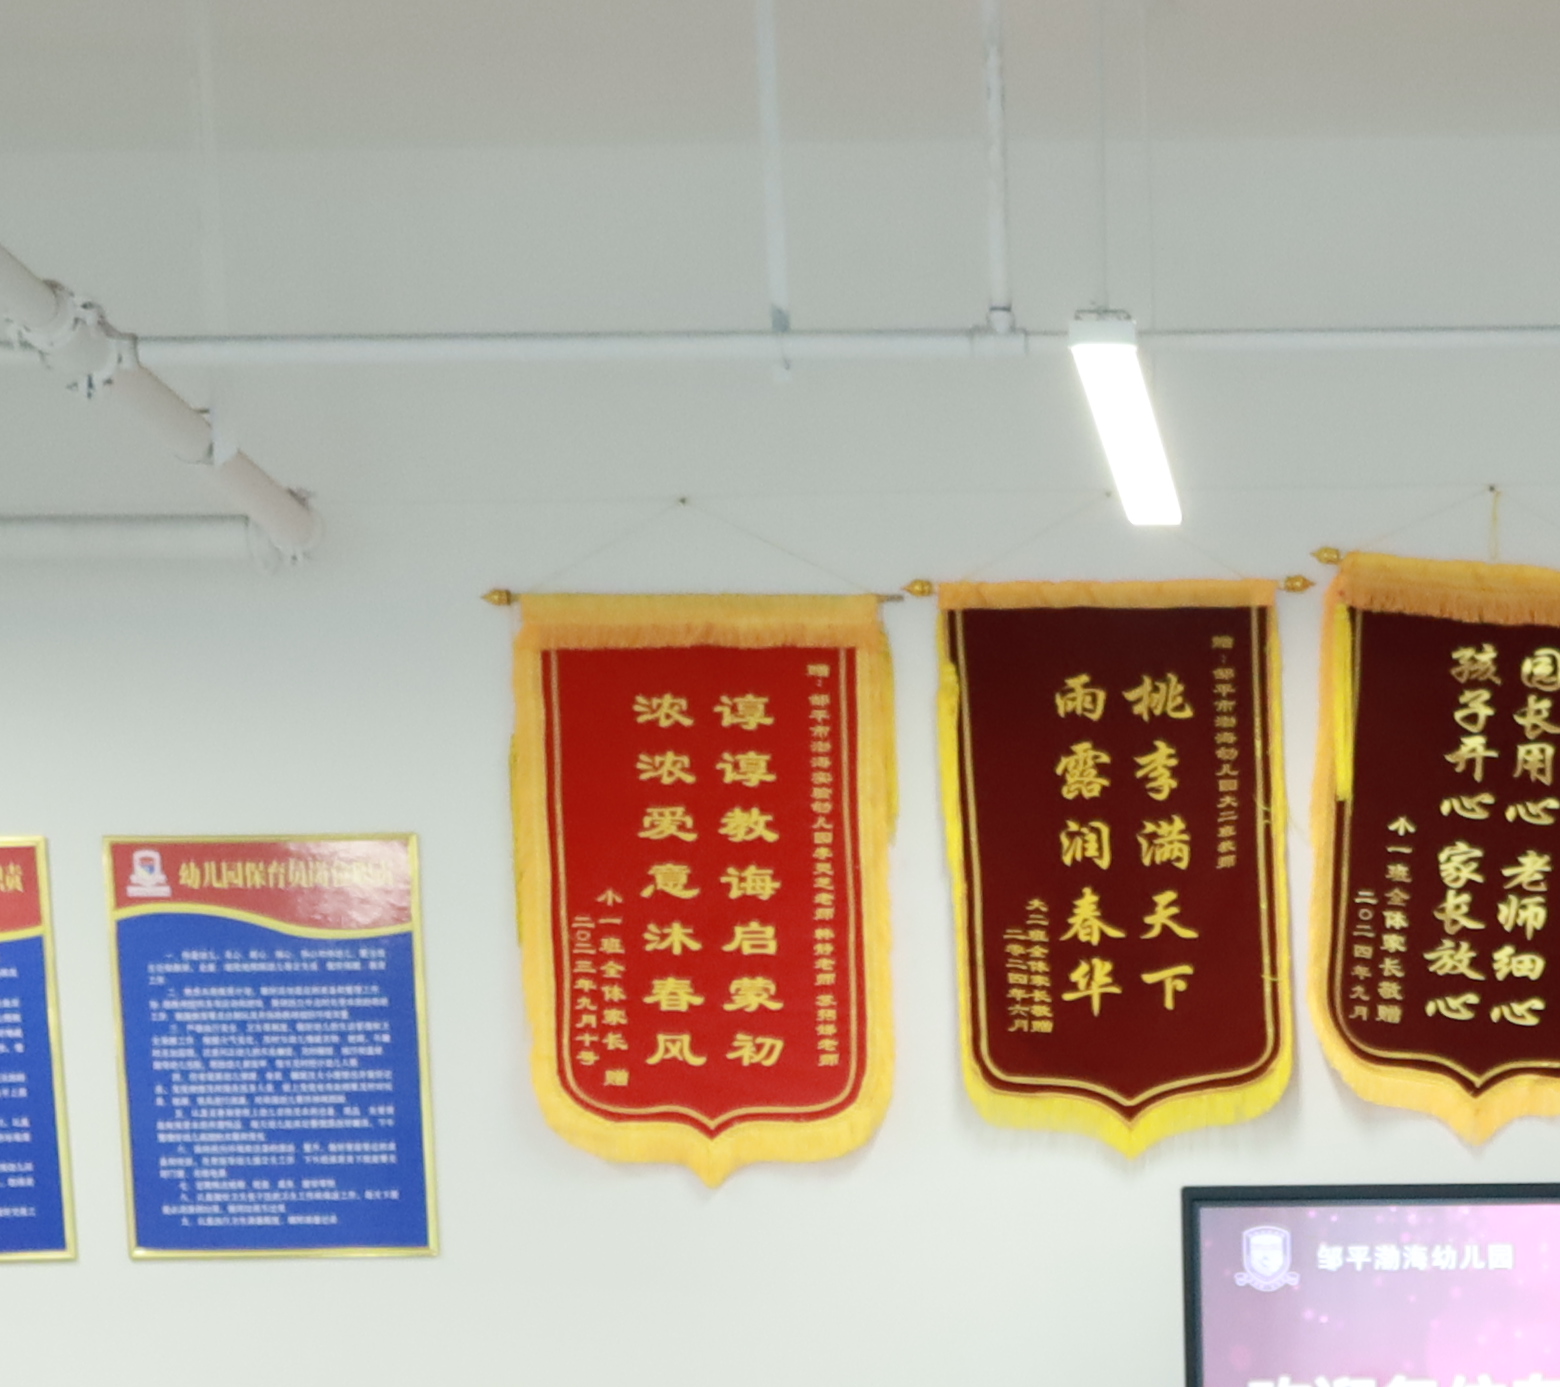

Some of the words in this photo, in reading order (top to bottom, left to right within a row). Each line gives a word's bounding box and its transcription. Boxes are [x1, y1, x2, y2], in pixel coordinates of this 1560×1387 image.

[178, 860, 395, 890] 幼儿园保育员岗位
[634, 692, 707, 1068] 浓浓爱意沐春风
[713, 692, 784, 1068] 谆谆教诲启蒙初
[1054, 673, 1127, 1017] 雨露润春华
[1121, 673, 1199, 1012] 桃李满天下
[1376, 815, 1416, 1025] 小一班全体家长敬赠
[597, 889, 628, 1050] 小一班全体家长
[1003, 929, 1029, 1032] 二零二四年六月
[1026, 899, 1054, 1033] 大二班全体家长敬赠
[1316, 1243, 1515, 1272] 邹平渤海幼儿园
